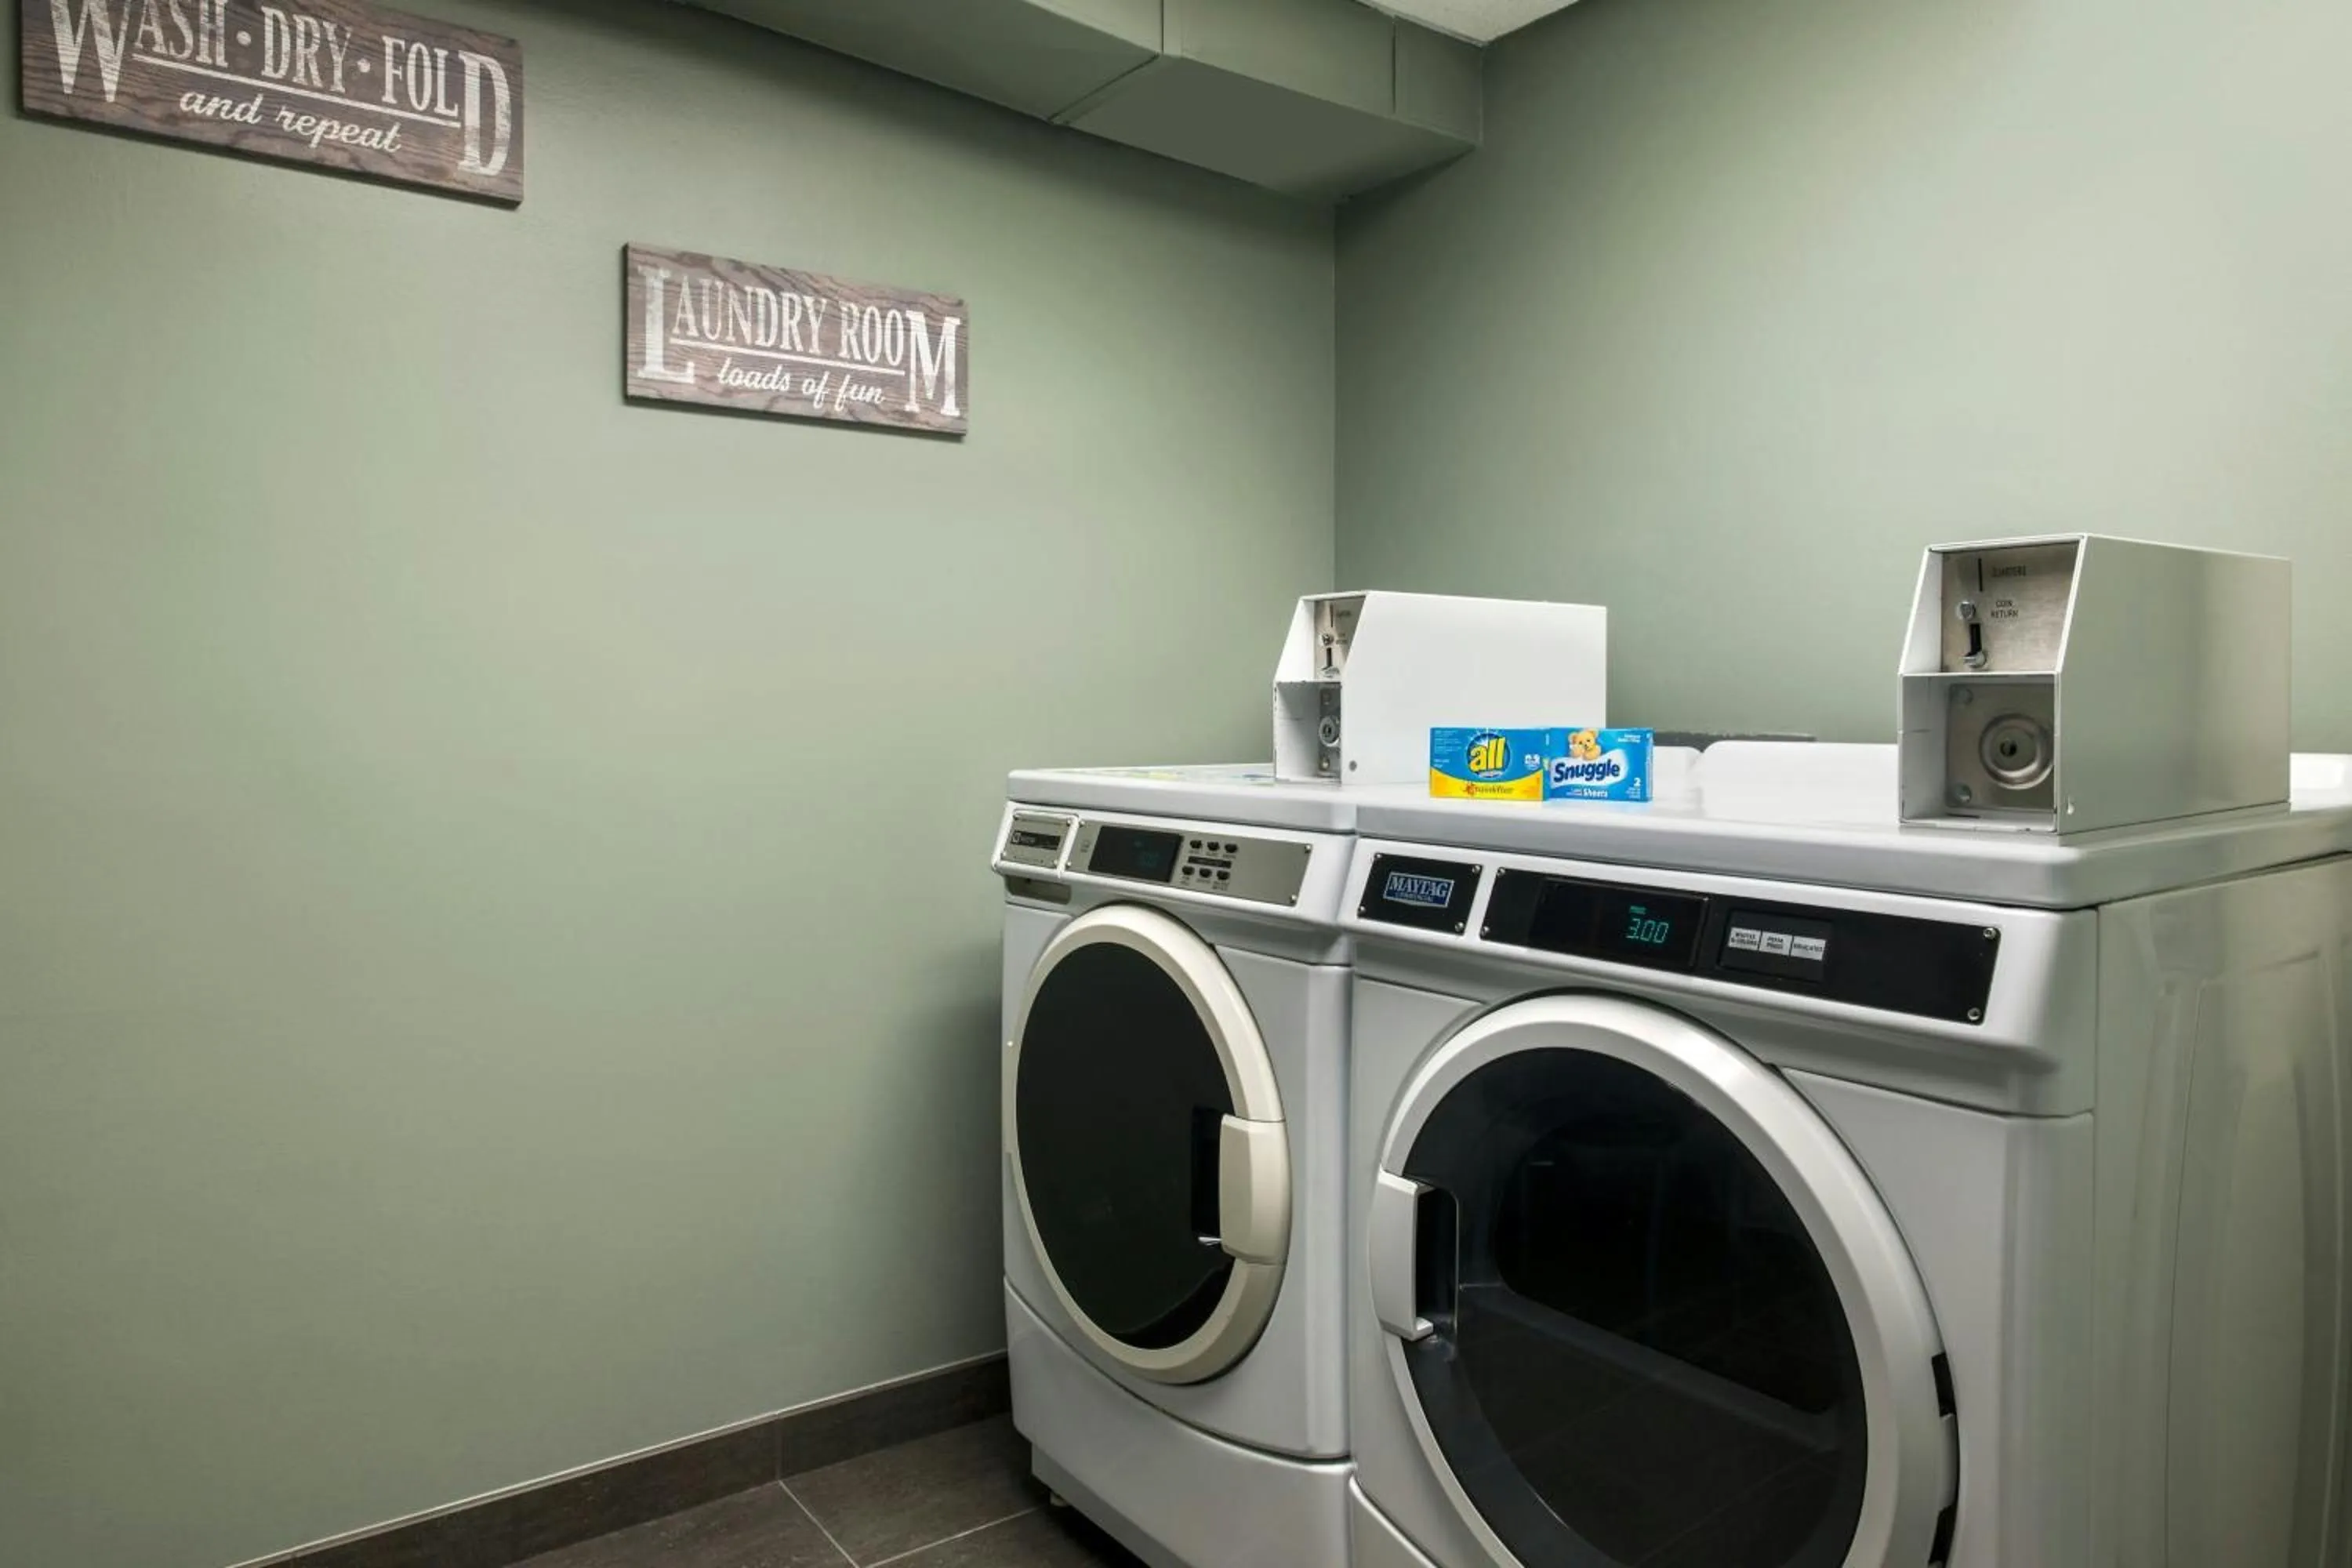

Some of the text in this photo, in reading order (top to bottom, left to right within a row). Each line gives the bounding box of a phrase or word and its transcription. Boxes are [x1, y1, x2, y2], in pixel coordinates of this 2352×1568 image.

[49, 0, 513, 176] WASH DRY FOLD
[180, 89, 402, 154] and repeat
[637, 265, 961, 416] LAUNDRY ROOM
[717, 358, 886, 412] loads of fun
[1468, 737, 1507, 772] all
[1553, 759, 1621, 783] Snuggle
[1389, 876, 1448, 897] MAYTAG
[1626, 918, 1669, 943] 3.00
